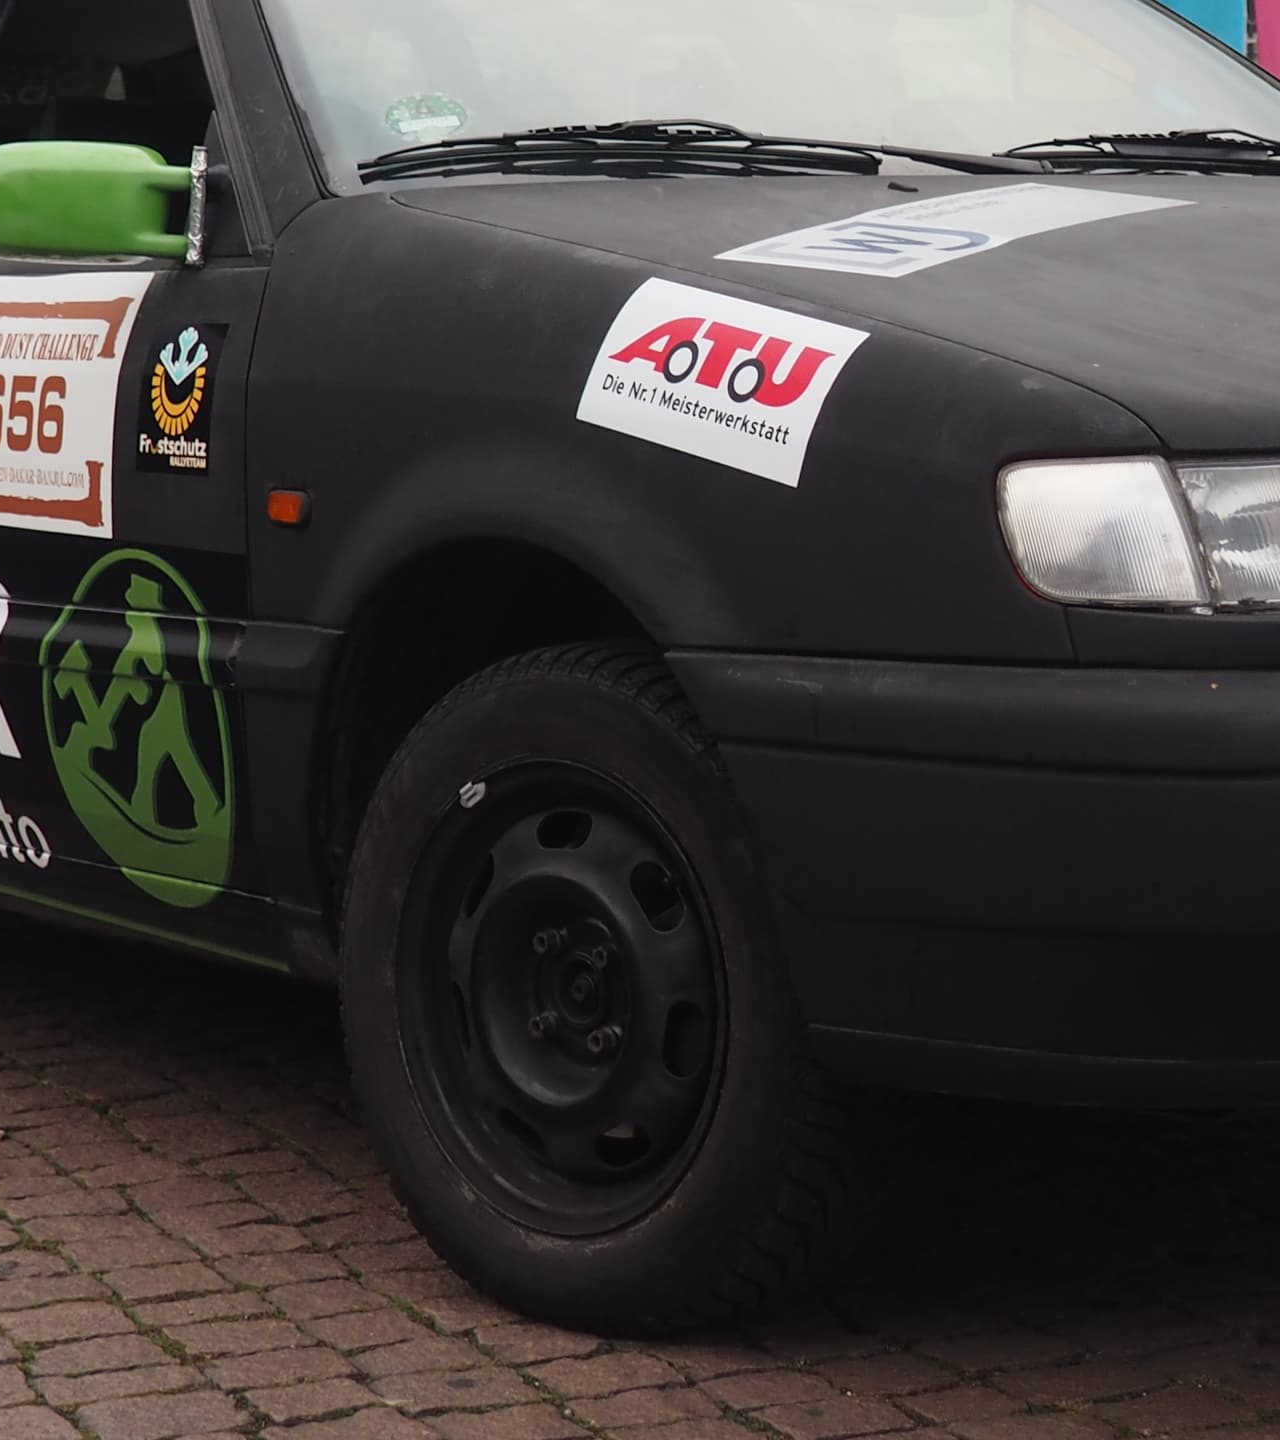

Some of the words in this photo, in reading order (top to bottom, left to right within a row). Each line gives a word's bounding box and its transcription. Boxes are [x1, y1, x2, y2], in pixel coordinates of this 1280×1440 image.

[0, 333, 34, 360] DUST
[31, 333, 99, 361] CHALLENGE
[601, 373, 625, 395] Die
[658, 391, 790, 446] Meisterwerkstatt
